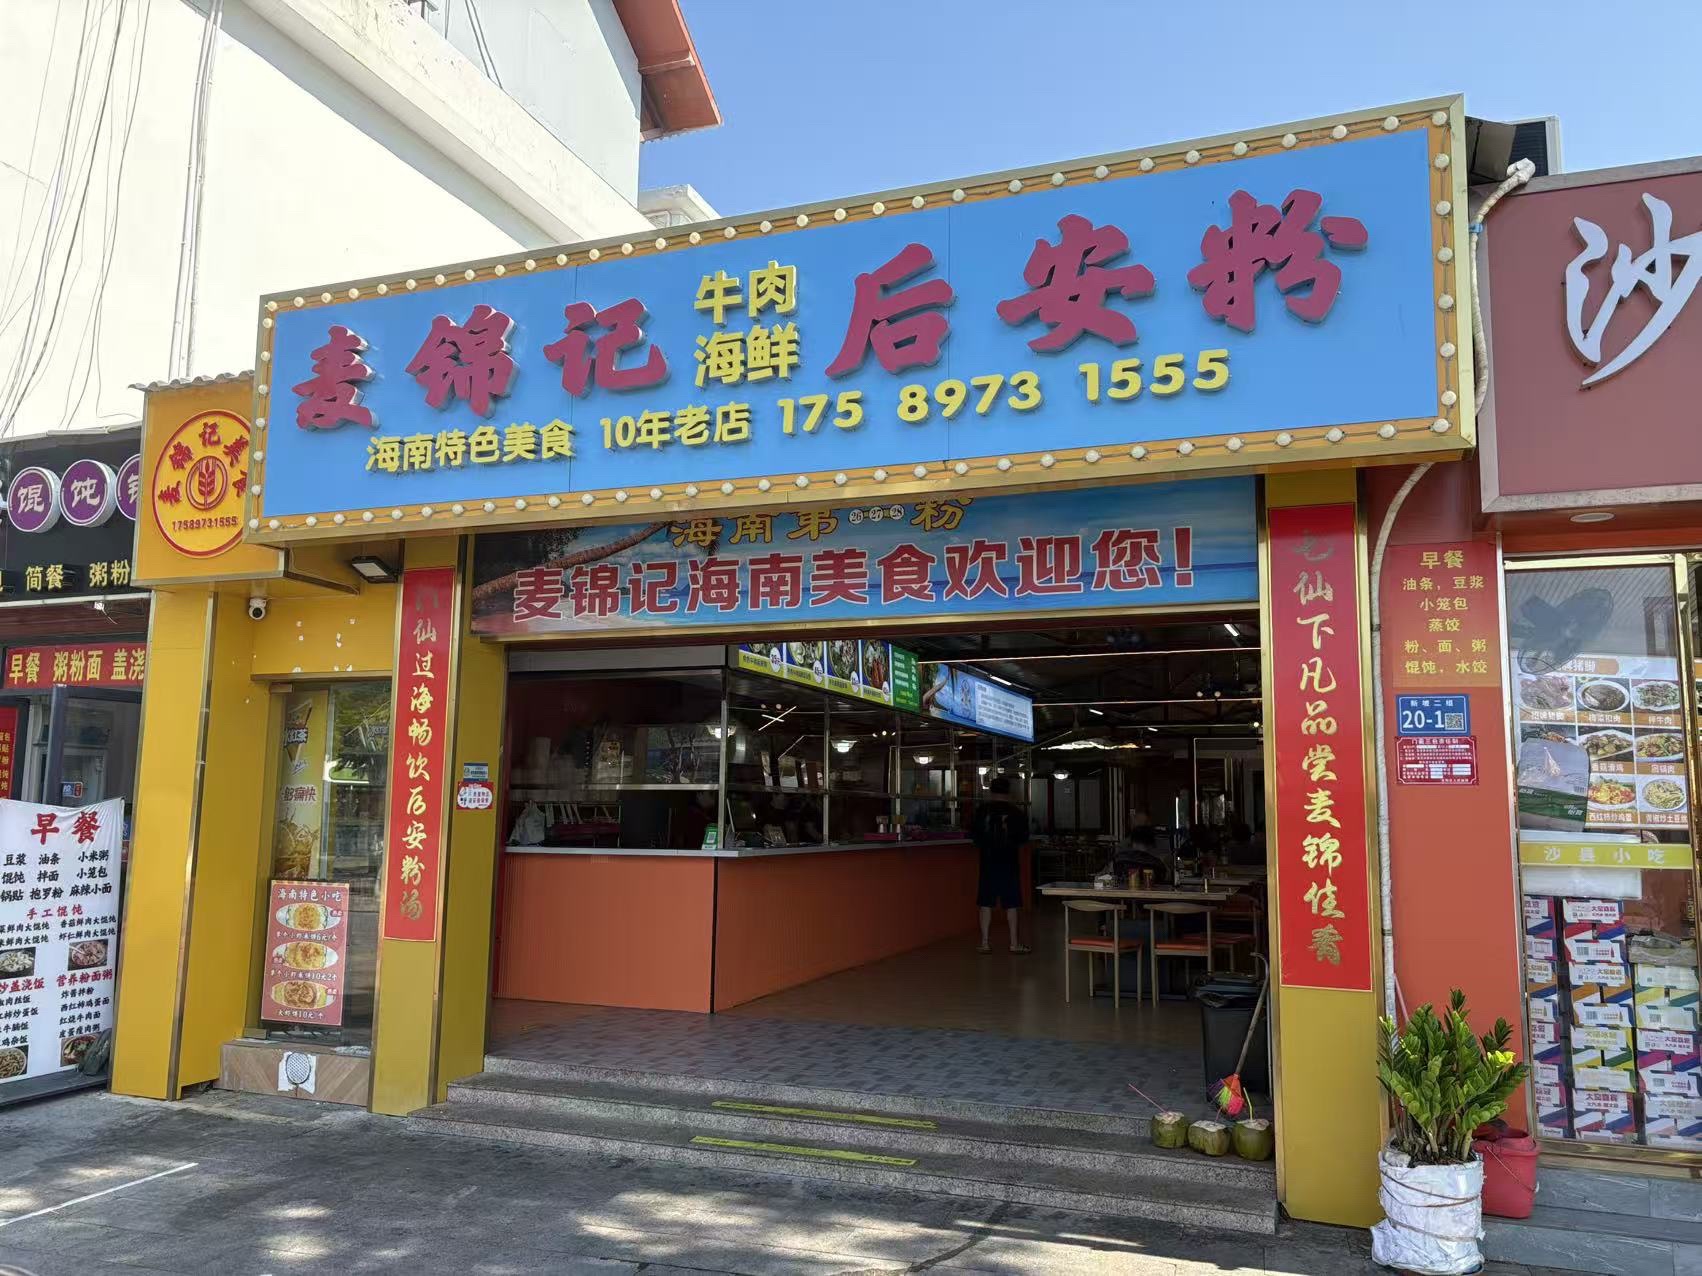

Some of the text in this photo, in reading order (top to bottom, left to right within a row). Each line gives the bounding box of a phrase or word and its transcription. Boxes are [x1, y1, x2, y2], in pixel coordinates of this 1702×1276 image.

[693, 259, 798, 326] 牛肉
[825, 189, 1369, 378] 后安粉
[1565, 192, 1702, 389] 沙
[292, 297, 668, 430] 麦锦记
[693, 321, 801, 388] 海鲜
[366, 348, 1231, 474] 海南特色美食 10年老店 175 8973 1555
[172, 515, 239, 532] 17589731555
[1420, 550, 1464, 569] 早餐
[25, 564, 65, 592] 简餐
[89, 559, 131, 588] 粥粉
[1420, 597, 1468, 611] 小笼包
[1428, 618, 1461, 632] 蒸饺
[9, 652, 41, 685] 早餐
[53, 649, 103, 683] 粥粉面
[1402, 710, 1445, 729] 20-1
[31, 811, 101, 846] 早餐
[3, 849, 110, 867] 豆浆 油条 小米粥
[1544, 848, 1666, 865] 沙县小吃
[2, 865, 108, 885] 馄饨 拌面 小笼包
[0, 889, 24, 902] 锅贴
[69, 882, 112, 897] 麻辣小面
[277, 888, 342, 902] 海南特色小吃
[27, 904, 83, 920] 手工馄饨
[56, 968, 113, 987] 营养粉面粥
[60, 996, 110, 1012] 西红柿鸡蛋面
[59, 1010, 101, 1025] 红烧牛肉面
